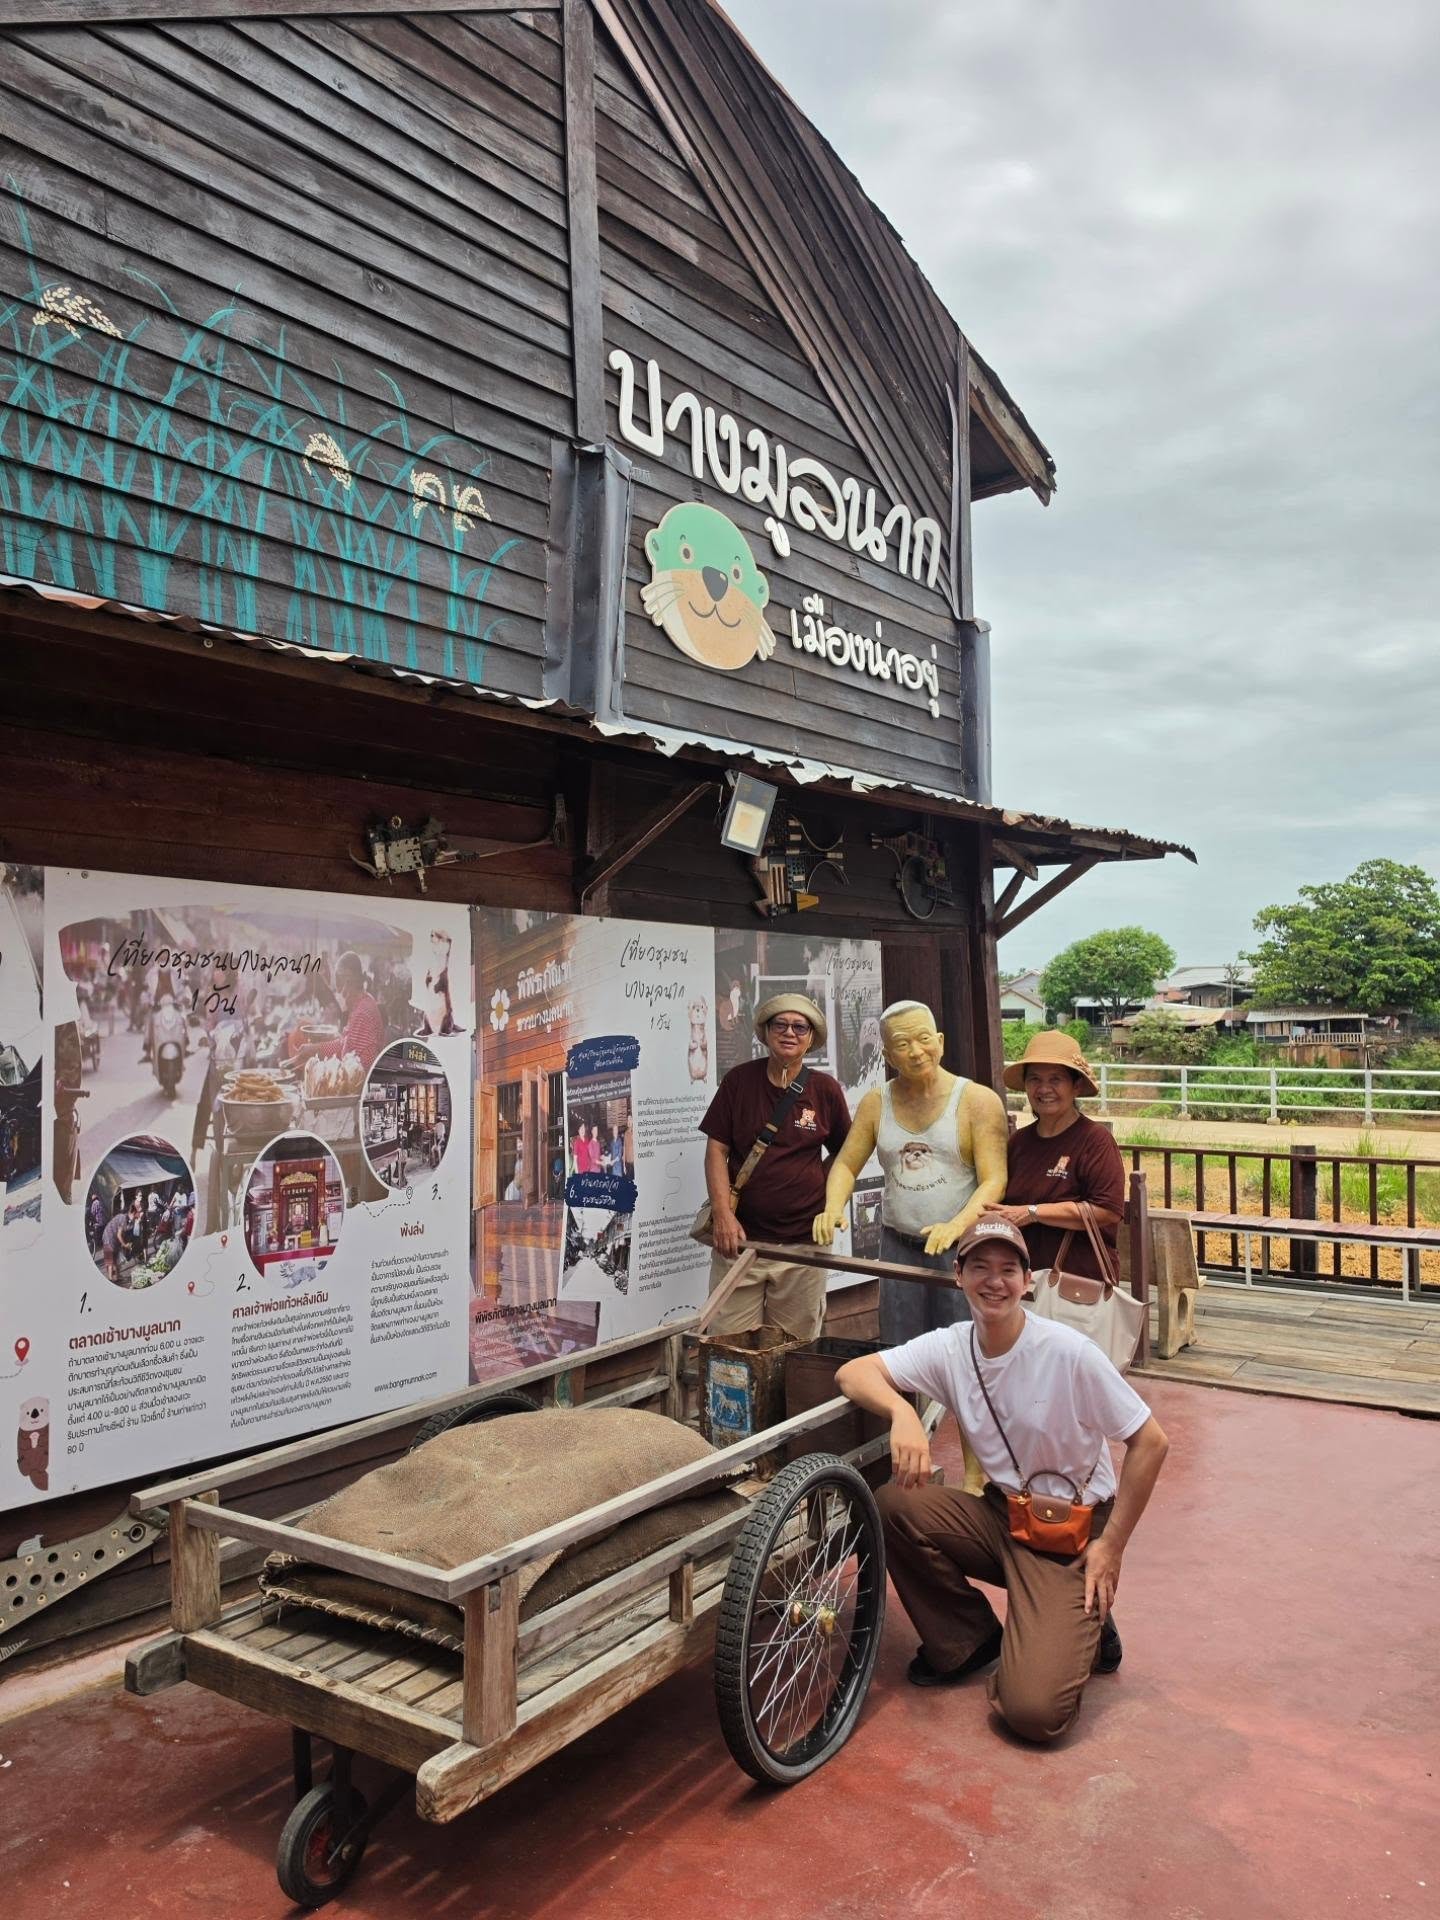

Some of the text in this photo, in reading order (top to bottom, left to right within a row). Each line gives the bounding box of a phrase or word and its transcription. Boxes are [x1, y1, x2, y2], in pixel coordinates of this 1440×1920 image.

[608, 349, 942, 588] บางมูลนาก
[790, 593, 941, 719] เมืองน่าอยู่
[107, 932, 322, 984] เที่ยวชุมชนบางมูลนาก
[620, 934, 689, 970] เที่ยวชุมชน
[191, 984, 238, 1015] 1 วัน
[625, 979, 686, 1008] บางมูลนาก
[431, 1183, 442, 1201] 3.
[236, 1272, 251, 1293] 2.
[79, 1291, 92, 1315] 1.
[232, 1290, 329, 1319] ศาลเจ้าพ่อแก้วหลังเดิม
[69, 1319, 181, 1350] ตลาดเช้าบางมูลนาก
